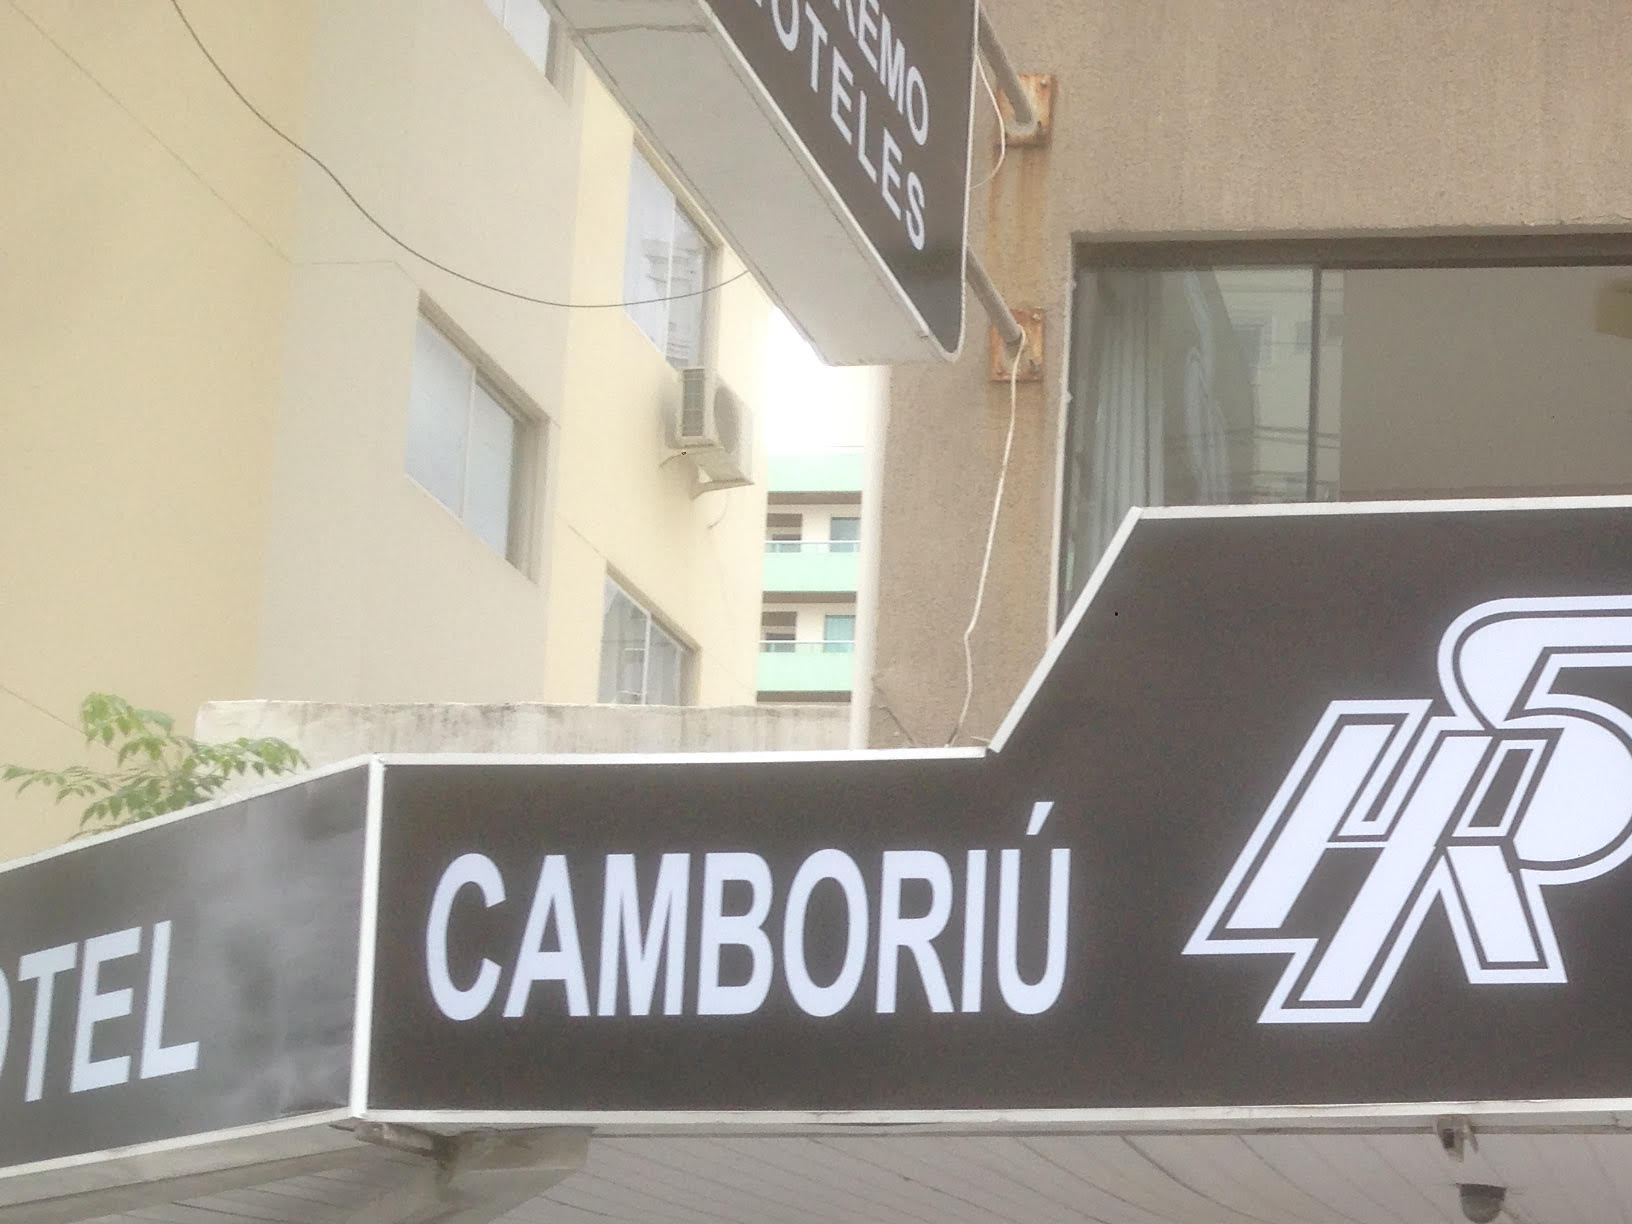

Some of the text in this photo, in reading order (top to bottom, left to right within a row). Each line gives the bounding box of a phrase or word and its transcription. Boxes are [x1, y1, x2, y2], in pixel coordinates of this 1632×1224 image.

[755, 0, 926, 251] OTELES
[0, 920, 200, 1103] TEL
[426, 801, 1071, 1021] CAMBORIÚ
